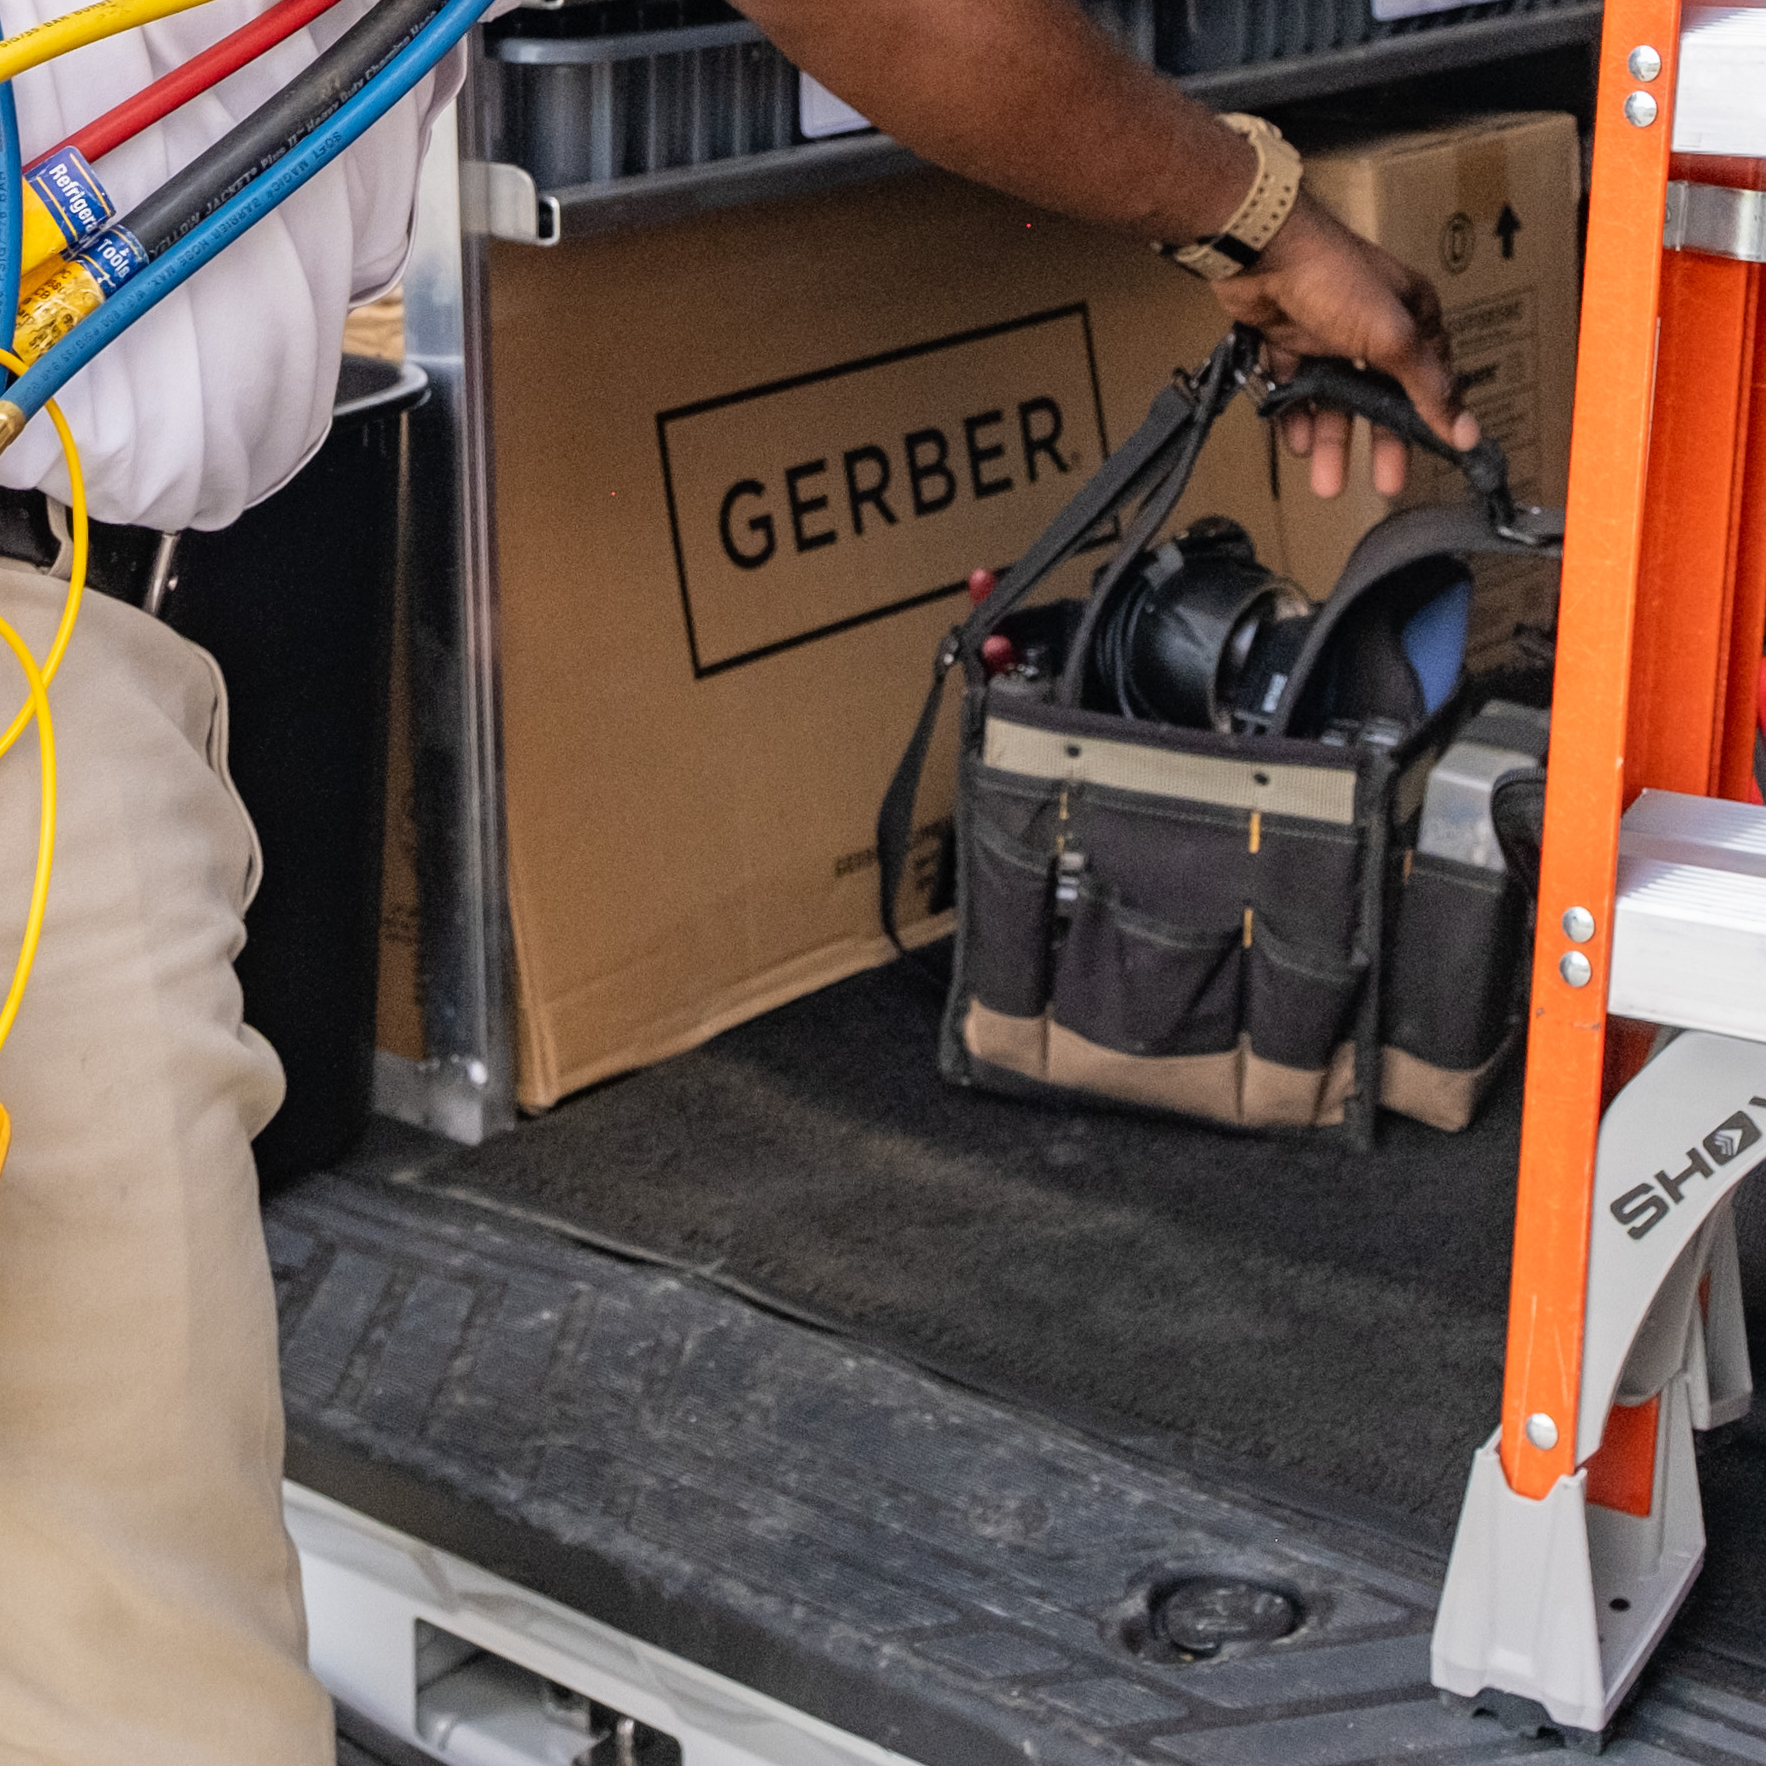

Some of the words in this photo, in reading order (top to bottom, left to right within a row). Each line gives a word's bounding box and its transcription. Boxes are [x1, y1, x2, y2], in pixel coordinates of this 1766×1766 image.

[259, 143, 288, 170] Plus
[97, 238, 131, 278] Tools
[719, 396, 1069, 569] GERBER
